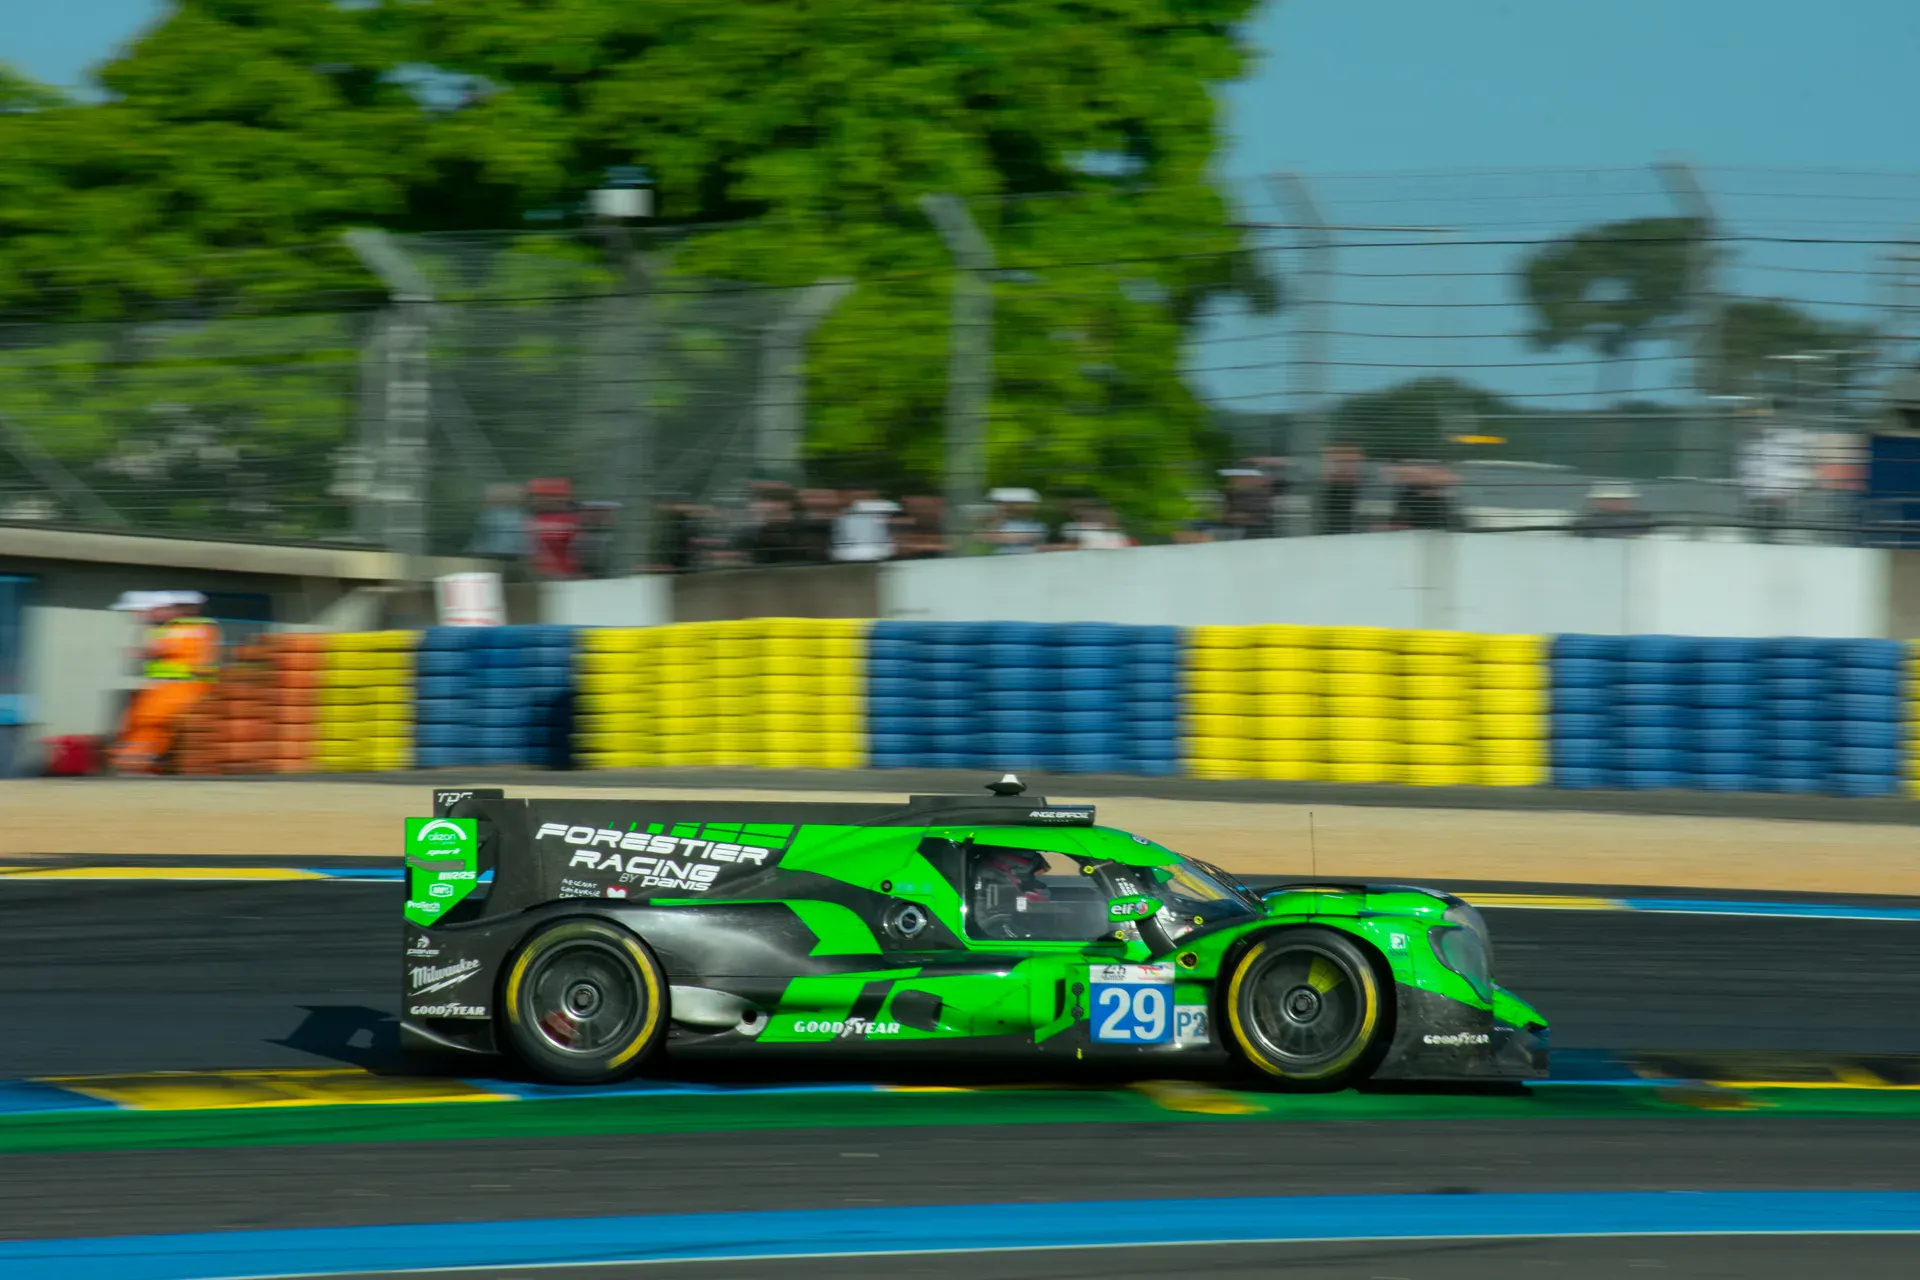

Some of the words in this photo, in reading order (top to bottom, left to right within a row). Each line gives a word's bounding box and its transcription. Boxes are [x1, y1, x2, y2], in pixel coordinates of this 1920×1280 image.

[535, 823, 769, 866] FORESTIER
[569, 850, 721, 882] RACING
[619, 872, 640, 884] BY
[1111, 904, 1136, 915] elf
[408, 958, 481, 989] Milwaukee
[410, 1003, 487, 1018] GOODYEAR
[1098, 987, 1166, 1040] 29
[793, 1017, 901, 1038] GOODYEAR
[1176, 1012, 1208, 1037] P2
[1423, 1032, 1490, 1047] GOODYEAR
